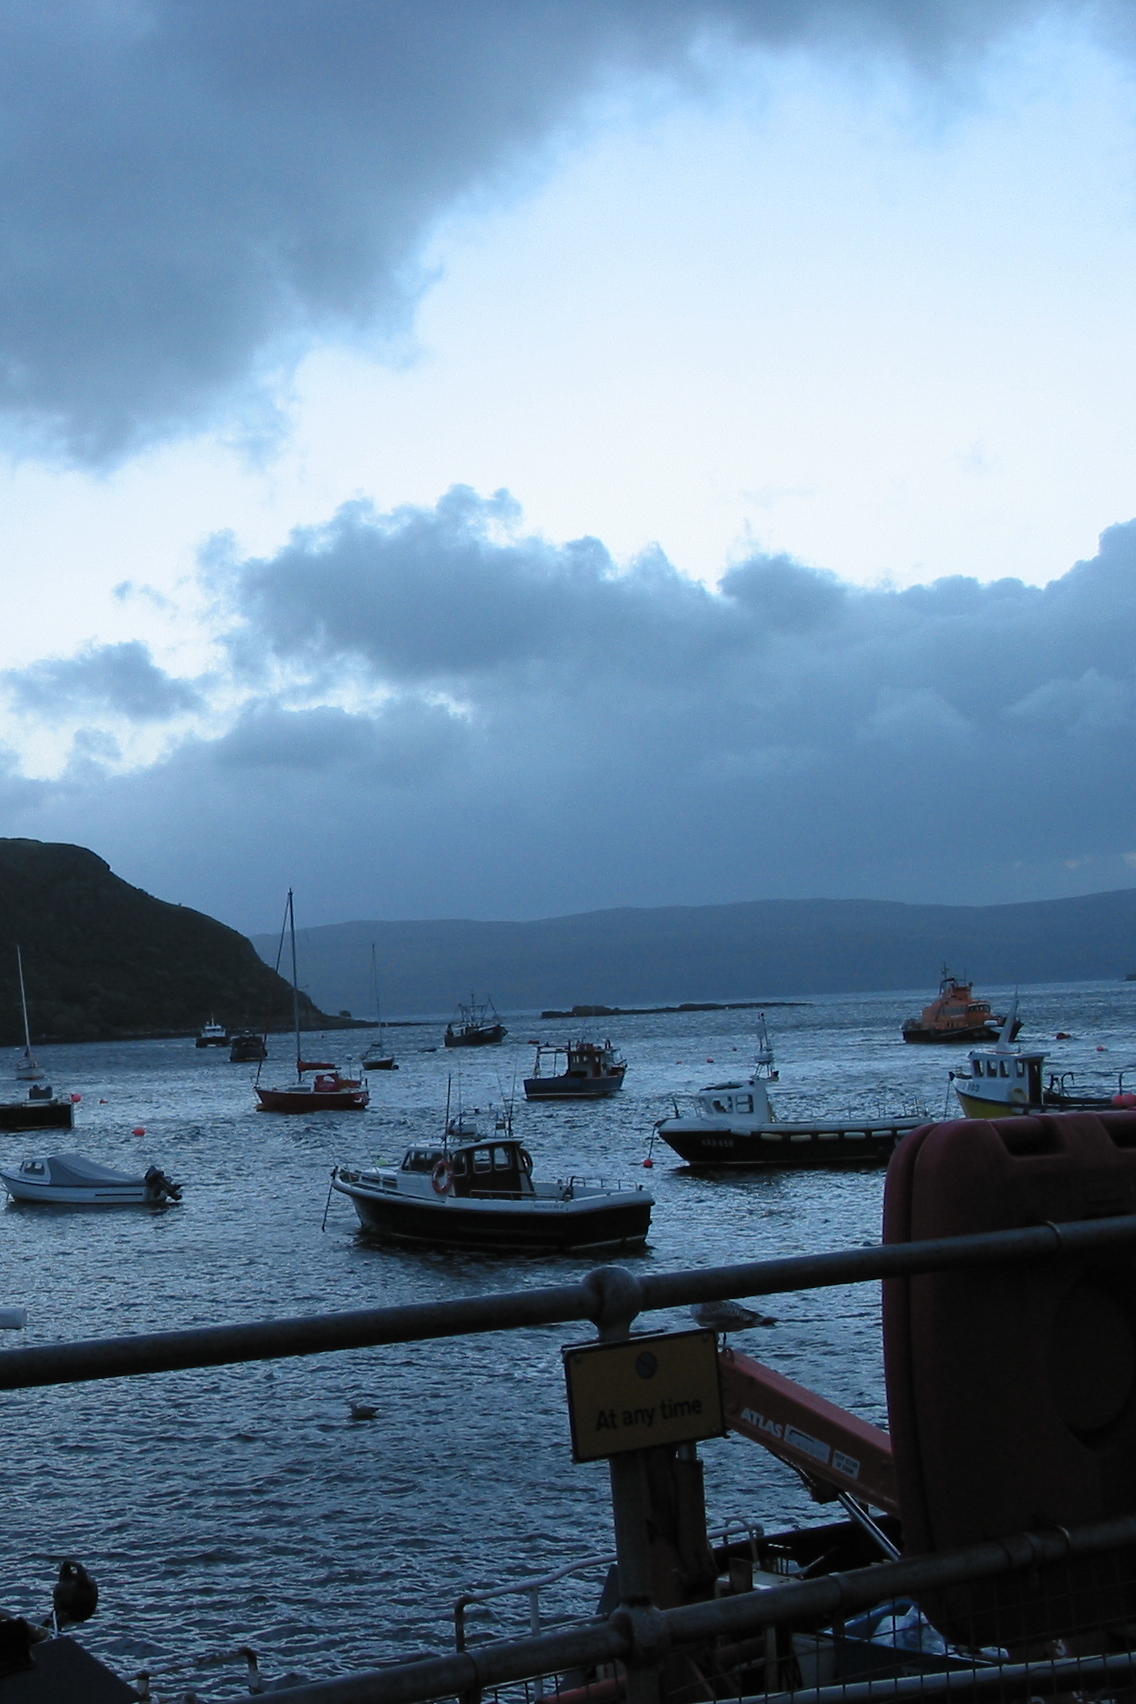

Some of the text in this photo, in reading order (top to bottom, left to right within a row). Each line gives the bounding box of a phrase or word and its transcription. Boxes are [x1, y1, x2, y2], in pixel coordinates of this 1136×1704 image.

[596, 1399, 702, 1431] At any time
[740, 1407, 783, 1438] ATLAS
